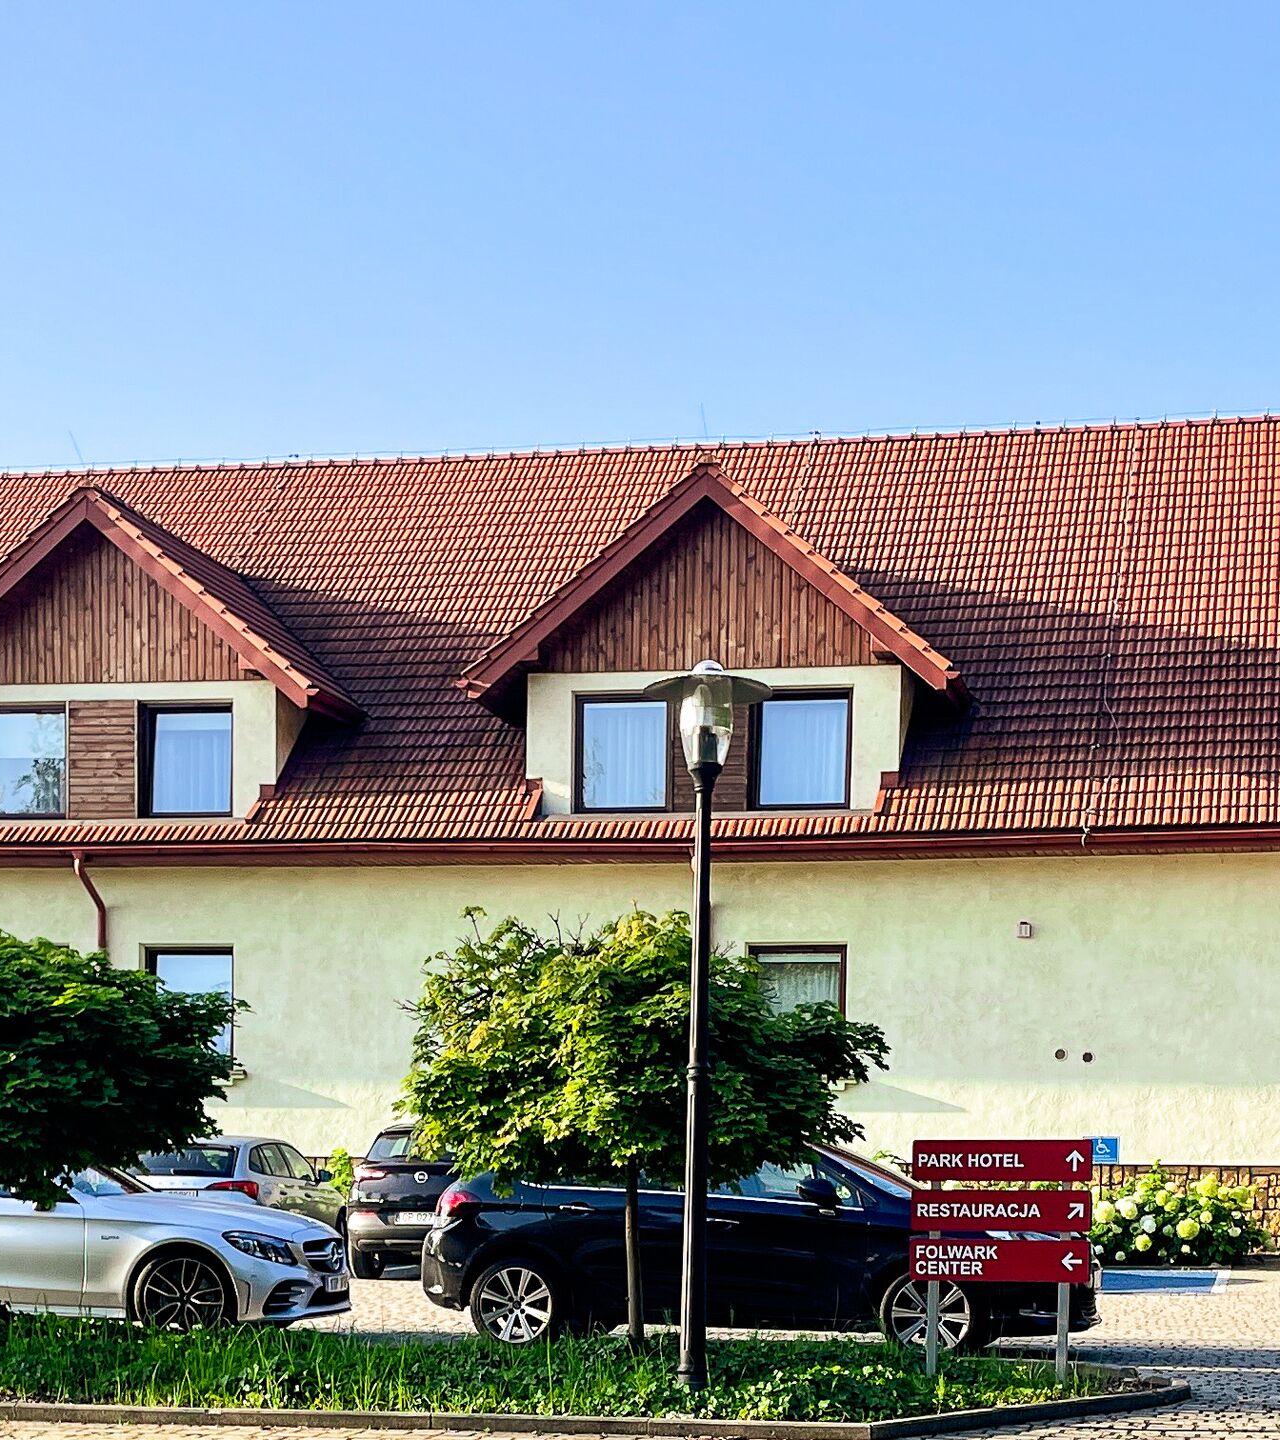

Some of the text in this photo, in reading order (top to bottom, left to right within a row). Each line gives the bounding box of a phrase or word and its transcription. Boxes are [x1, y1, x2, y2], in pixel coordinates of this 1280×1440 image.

[917, 1153, 1024, 1168] PARK HOTEL
[916, 1203, 1040, 1218] RESTAURACJA
[915, 1245, 998, 1260] FOLWARK
[915, 1260, 984, 1275] CENTER
